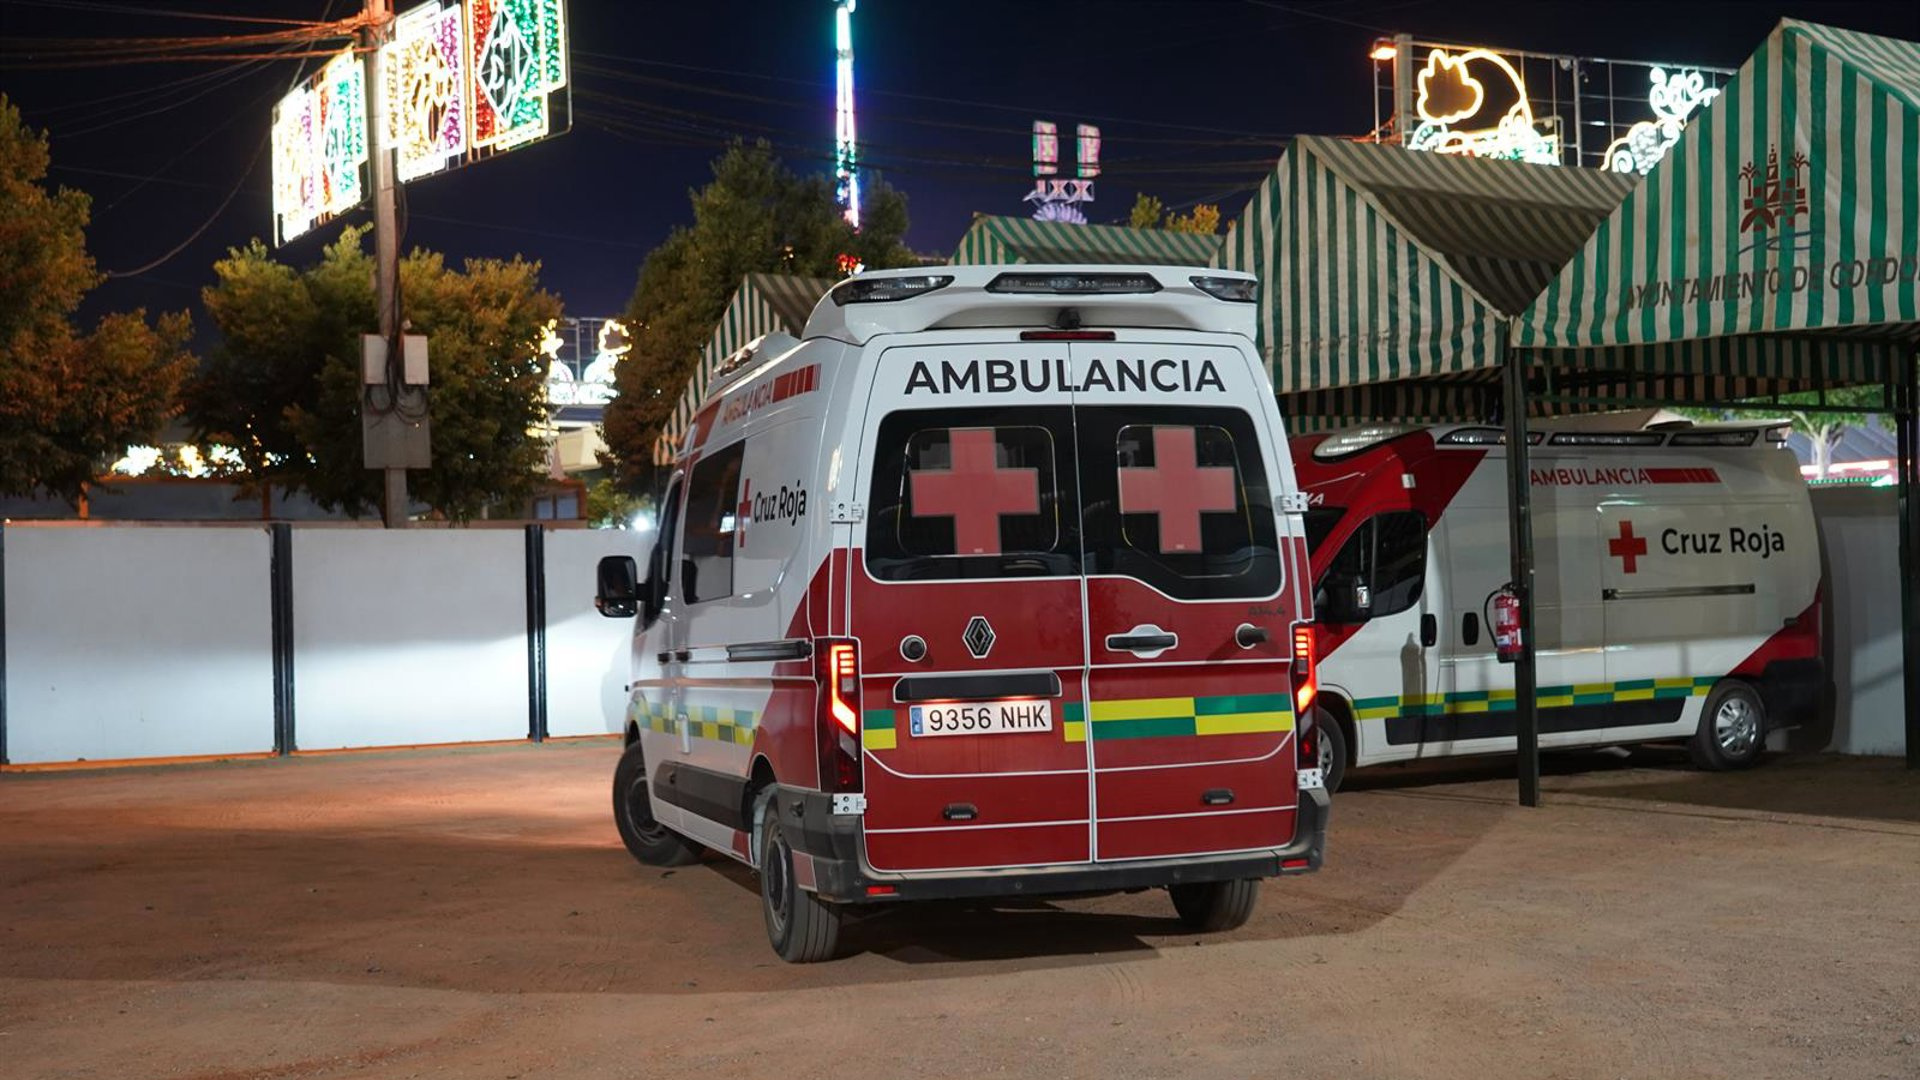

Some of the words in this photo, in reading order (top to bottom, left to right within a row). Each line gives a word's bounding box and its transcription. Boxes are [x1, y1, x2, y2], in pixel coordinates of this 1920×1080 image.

[1626, 266, 1783, 310] AYUNTAMIENTO
[1791, 263, 1825, 293] DE
[1829, 255, 1920, 290] CORDO
[904, 359, 1226, 395] AMBULANCIA
[1530, 468, 1651, 486] AMBULANCIA
[754, 491, 777, 523] Cruz
[778, 479, 807, 527] Roja
[1661, 528, 1722, 555] Cruz
[1729, 524, 1785, 559] Roja
[929, 707, 992, 731] 9356
[1001, 705, 1046, 729] NHK
